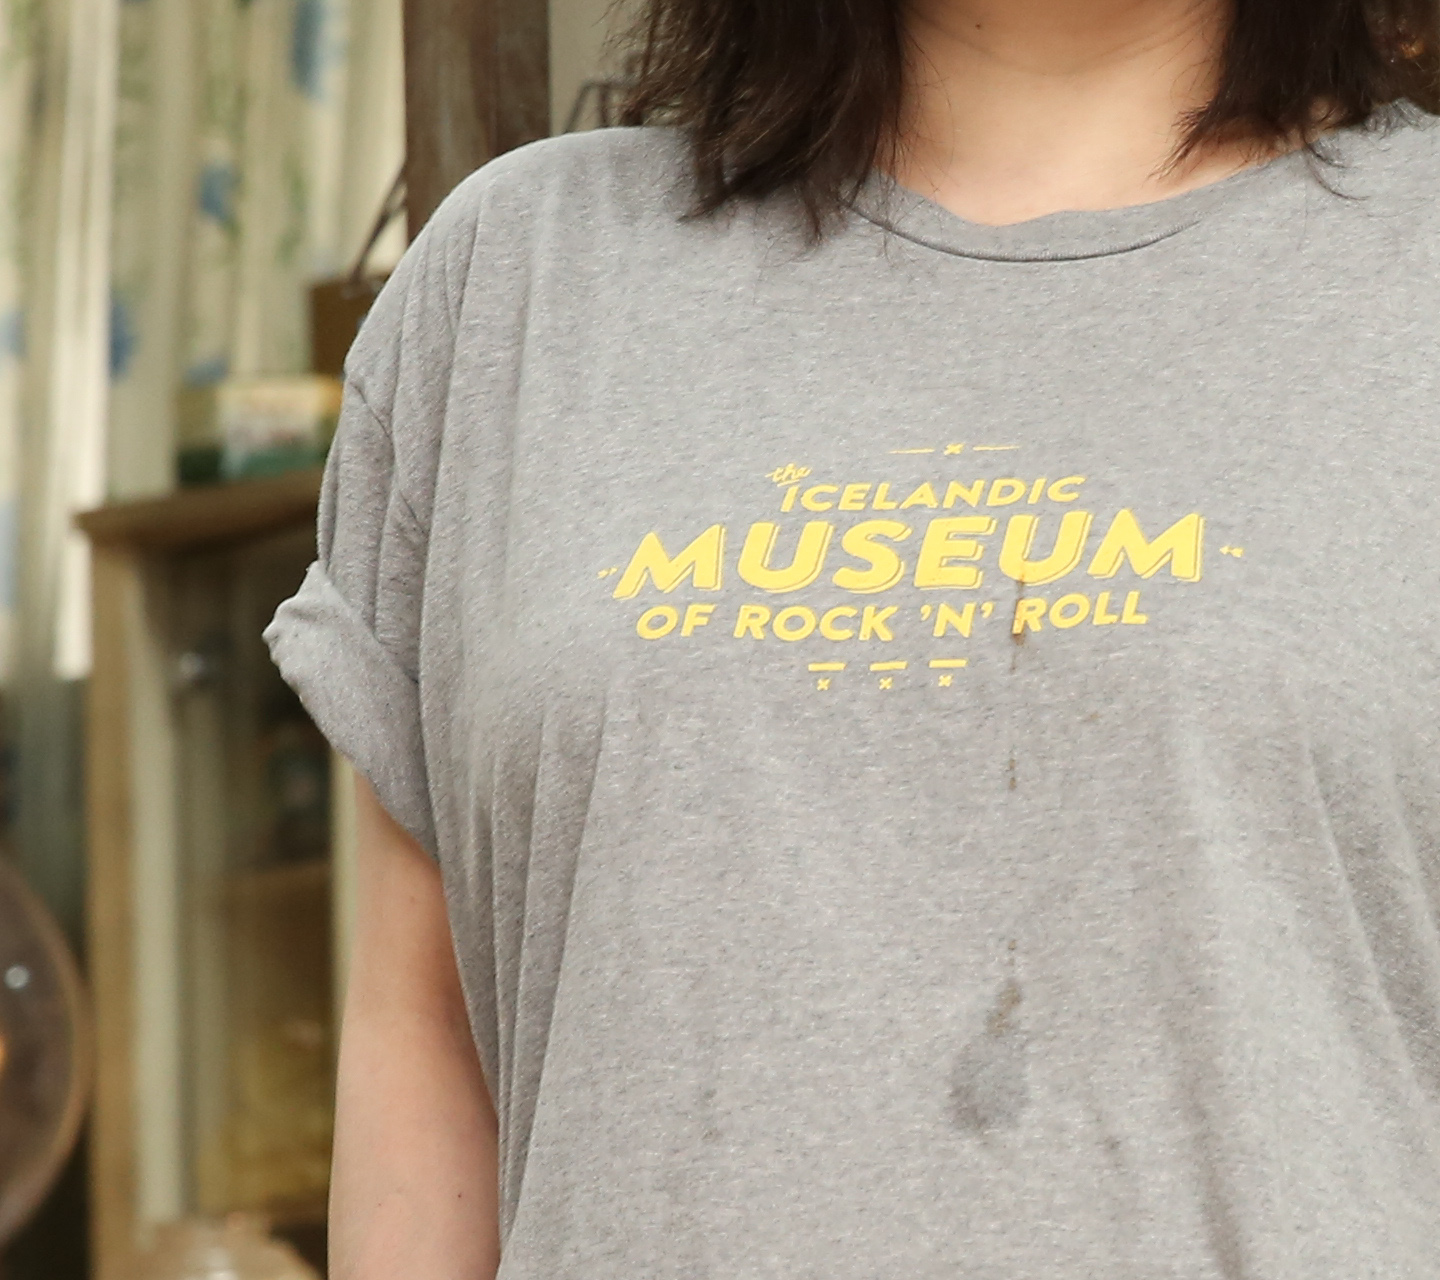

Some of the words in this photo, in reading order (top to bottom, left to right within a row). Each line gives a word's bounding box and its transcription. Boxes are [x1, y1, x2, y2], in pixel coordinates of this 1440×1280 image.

[766, 463, 812, 486] the
[780, 476, 1086, 513] ICELANDIC
[613, 508, 1205, 599] MUSEUM
[635, 604, 715, 640] OF
[733, 602, 900, 642] ROCK
[1012, 591, 1148, 636] ROLL
